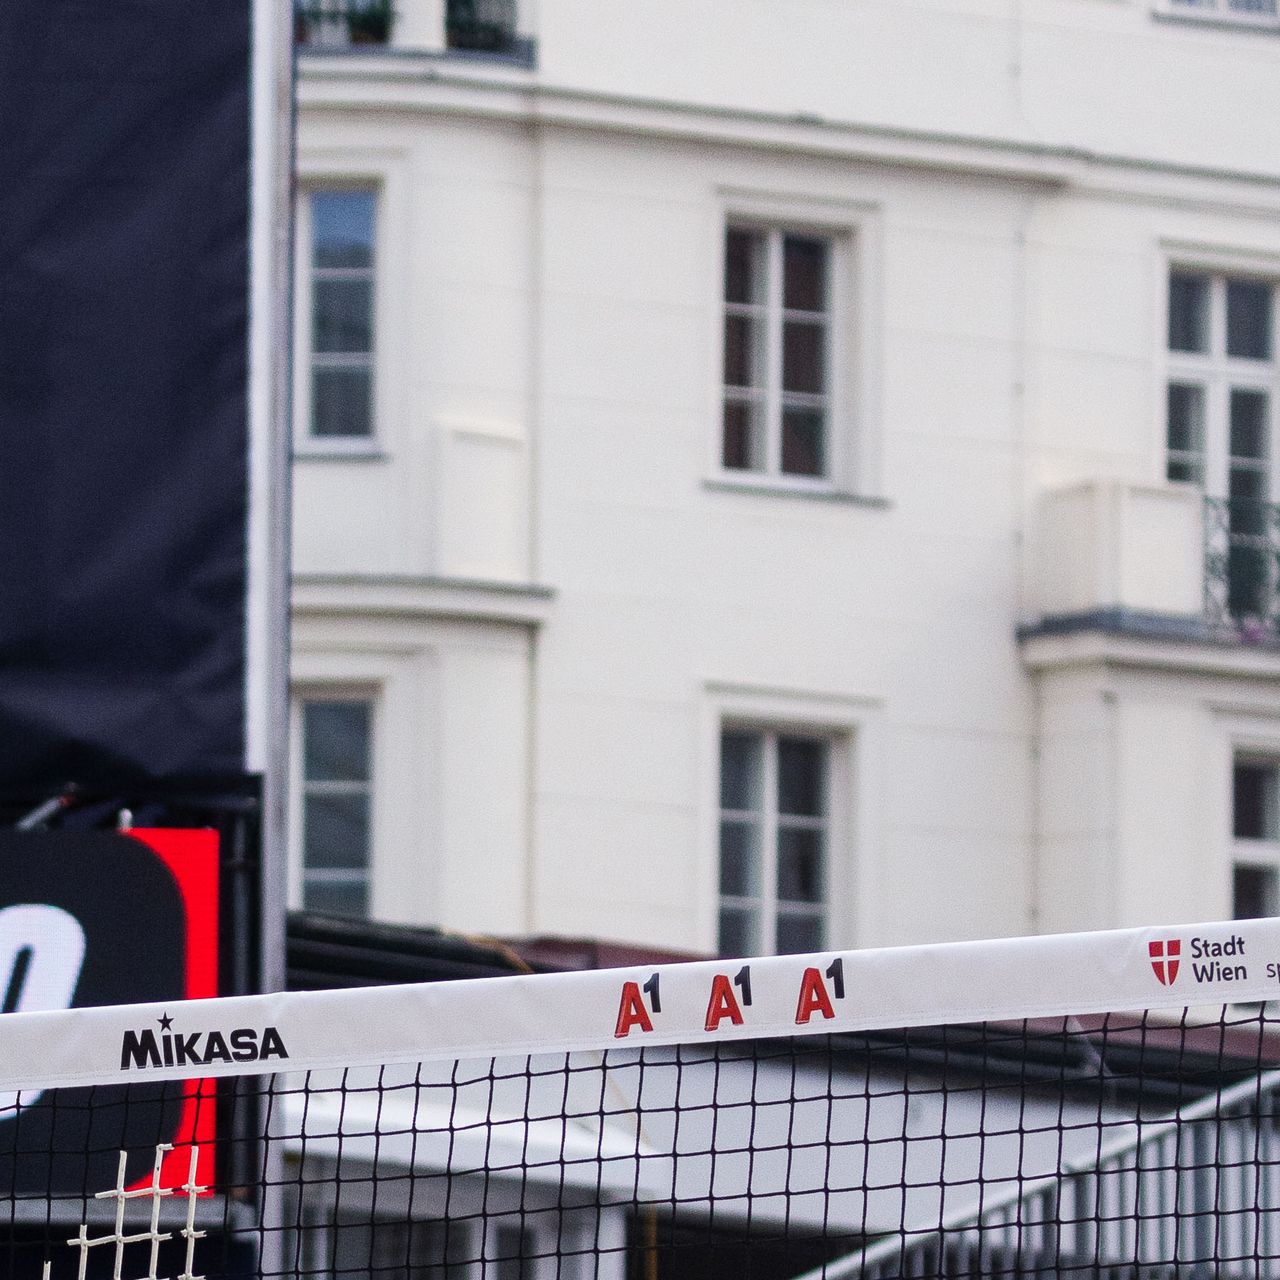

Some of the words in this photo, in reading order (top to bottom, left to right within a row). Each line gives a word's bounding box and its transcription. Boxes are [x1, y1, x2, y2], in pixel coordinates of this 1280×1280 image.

[1190, 934, 1246, 959] Stadt
[1191, 961, 1248, 984] Wien
[614, 972, 662, 1039] A1
[704, 965, 753, 1032] A1
[795, 957, 846, 1025] A1
